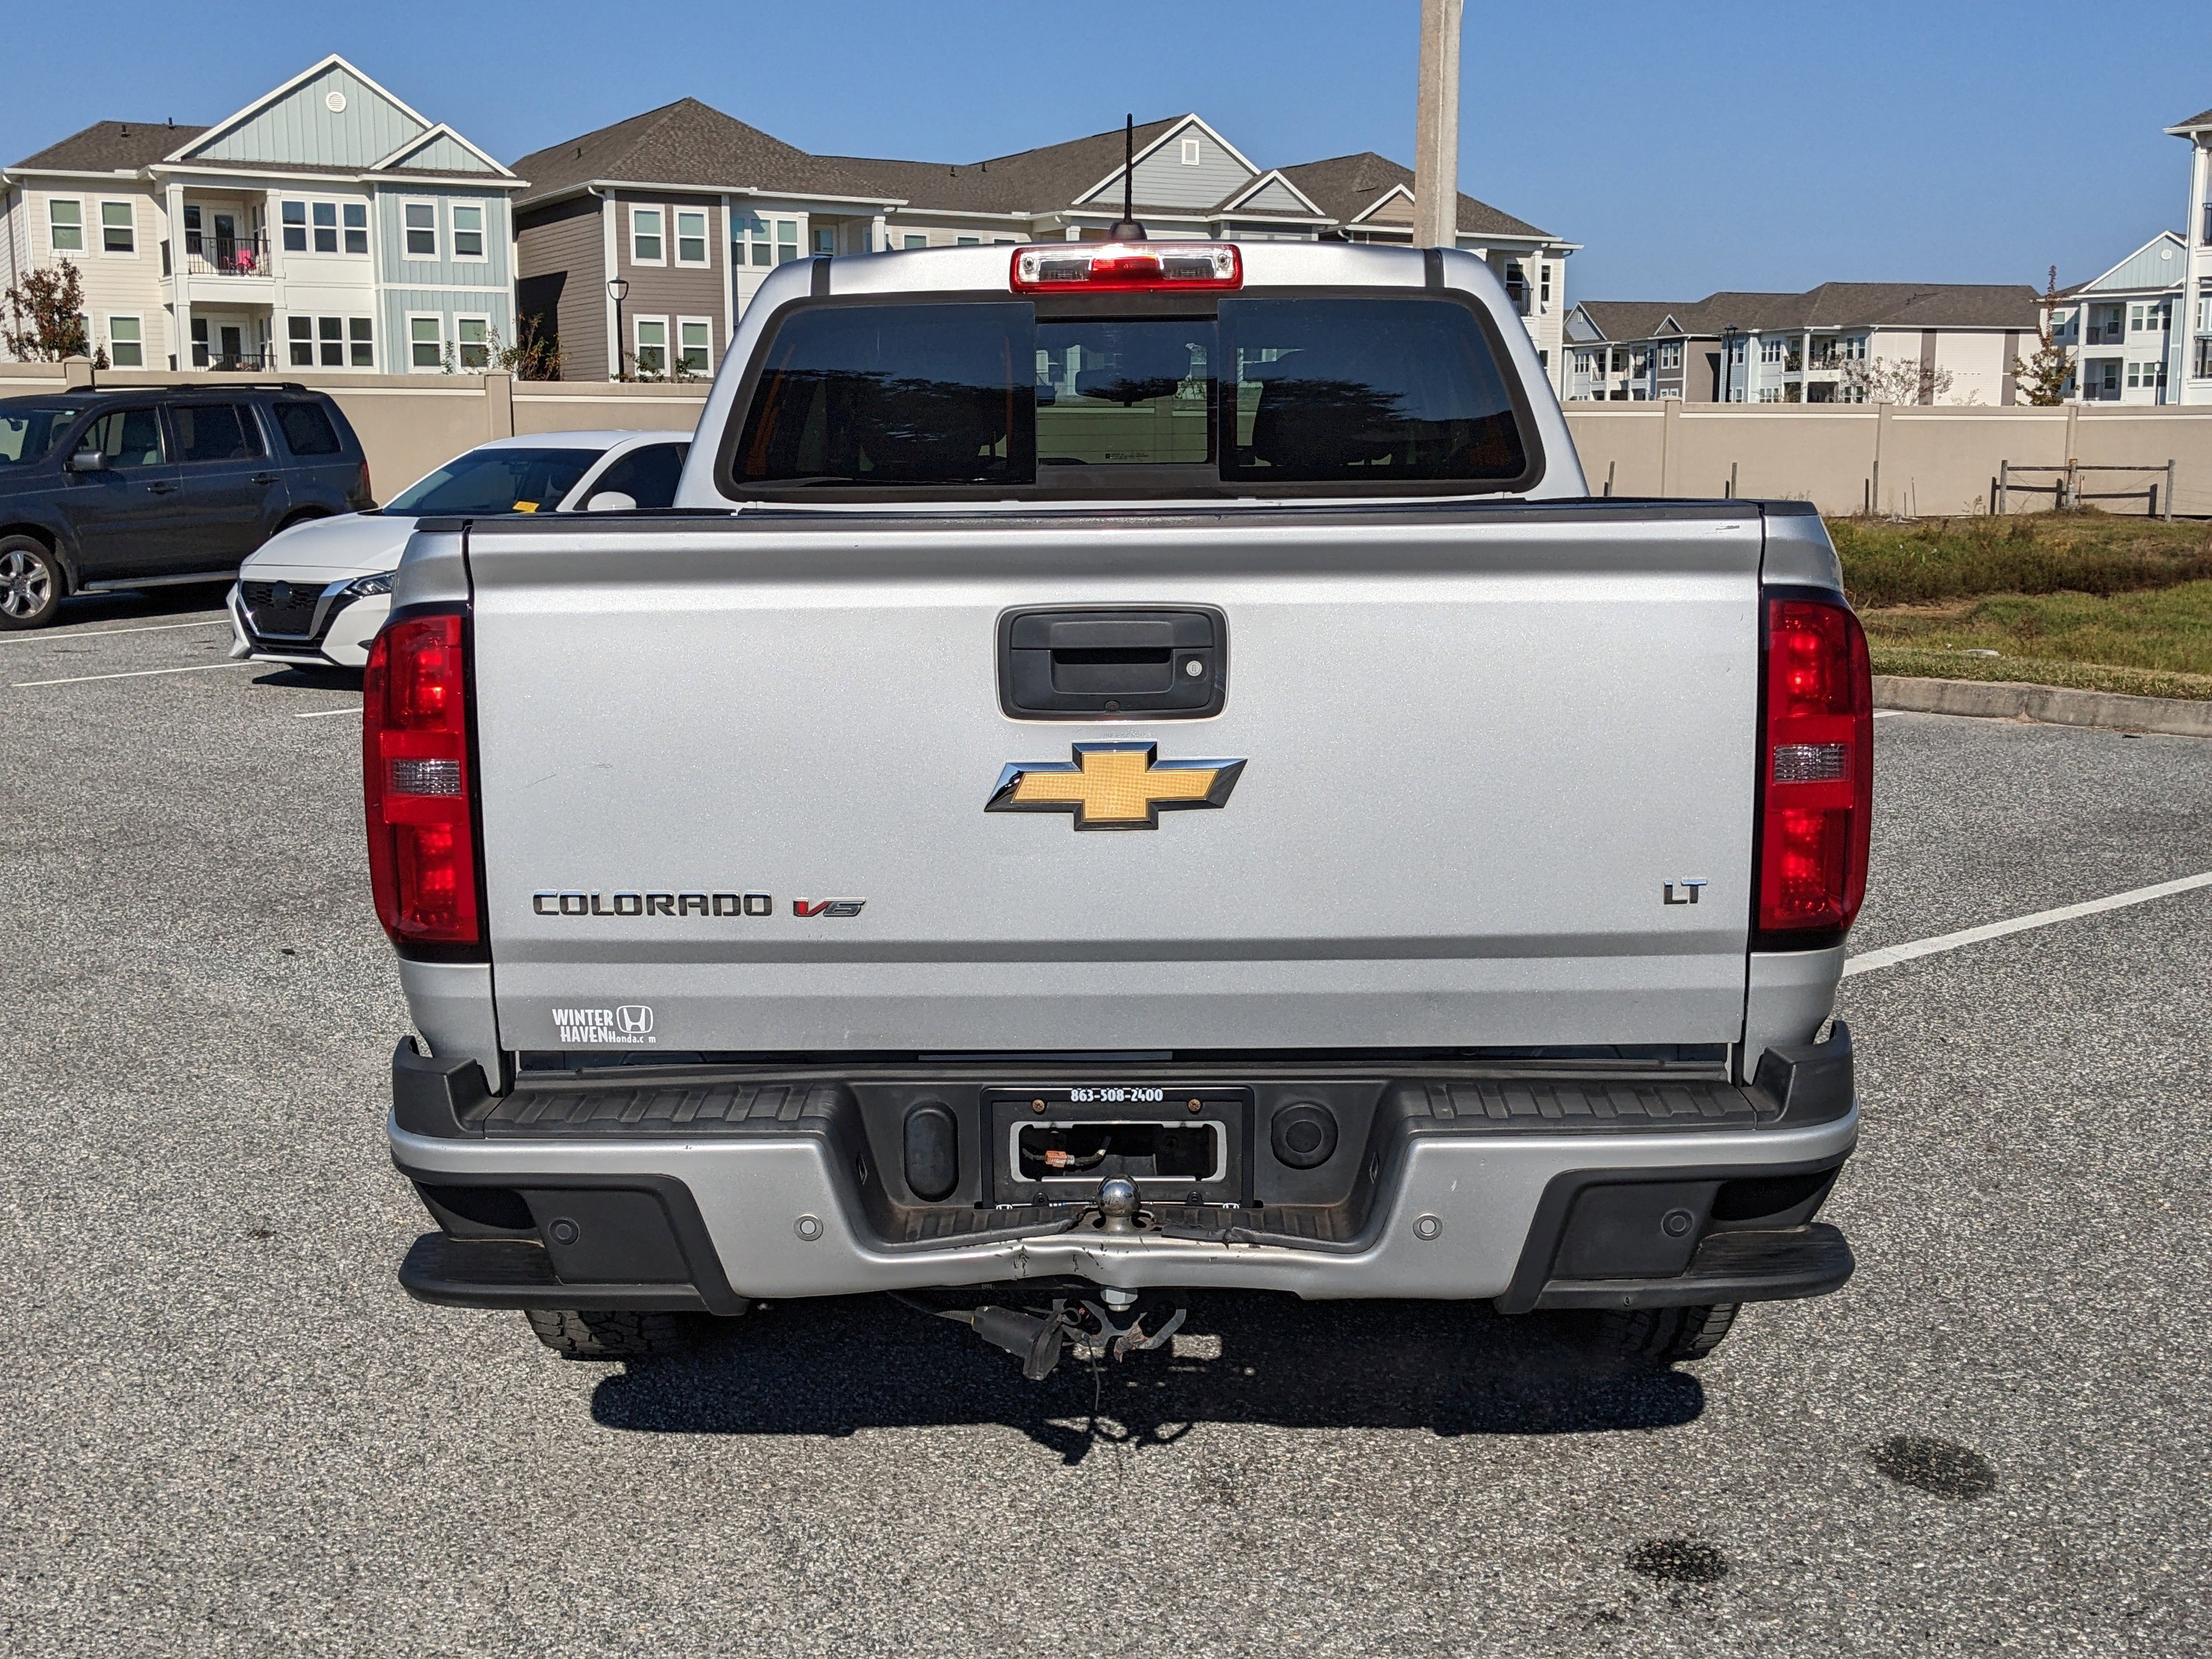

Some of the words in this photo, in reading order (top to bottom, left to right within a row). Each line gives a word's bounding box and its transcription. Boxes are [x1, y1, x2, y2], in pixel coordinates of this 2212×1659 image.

[1663, 878, 1707, 905] LT
[533, 890, 772, 916] COLORADO
[793, 897, 866, 917] V6
[552, 1009, 613, 1026] WINTER
[560, 1026, 608, 1043] HAVEN
[1071, 1088, 1164, 1102] 863-508-2400
